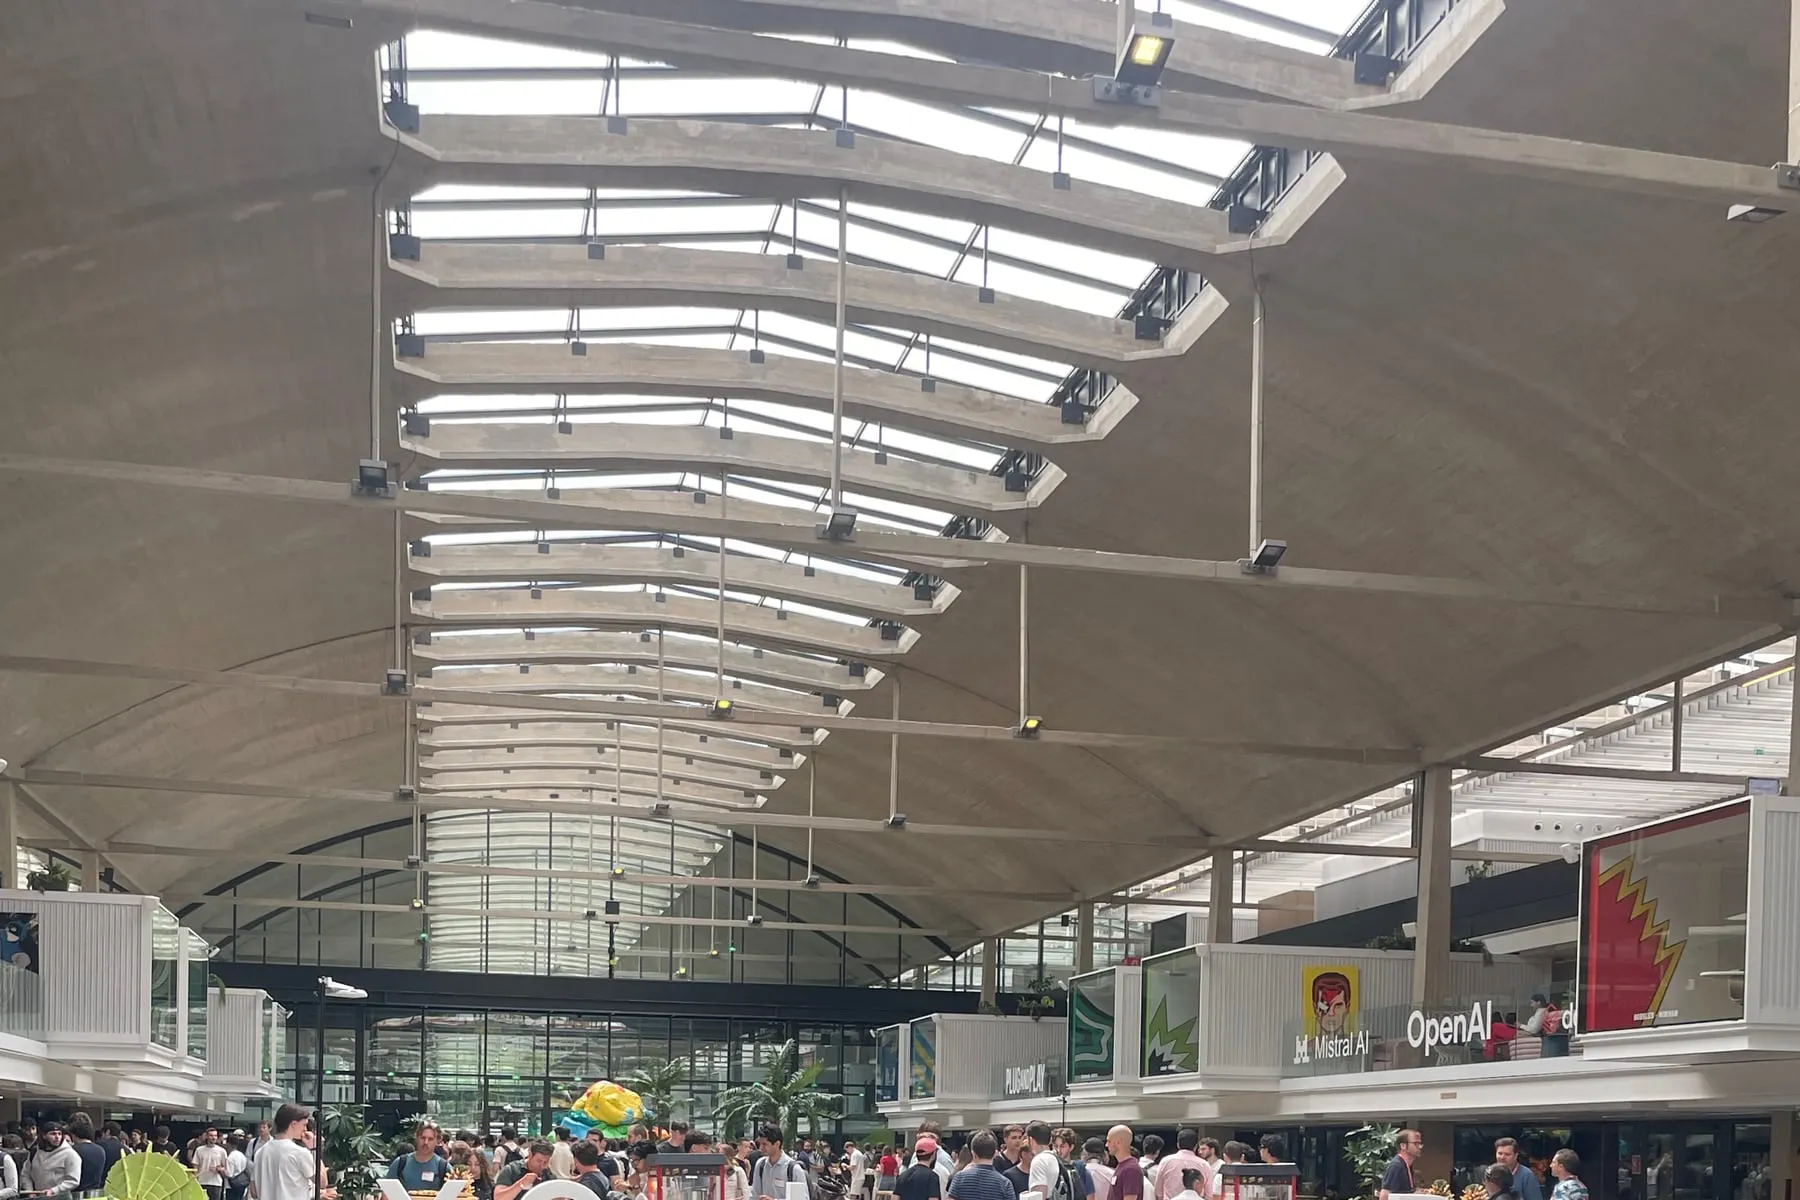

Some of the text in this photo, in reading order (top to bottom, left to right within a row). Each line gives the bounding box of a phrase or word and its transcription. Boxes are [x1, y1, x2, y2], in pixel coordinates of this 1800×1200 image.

[1314, 1030, 1369, 1060] Mistral AI
[1407, 1000, 1492, 1057] OpenAI
